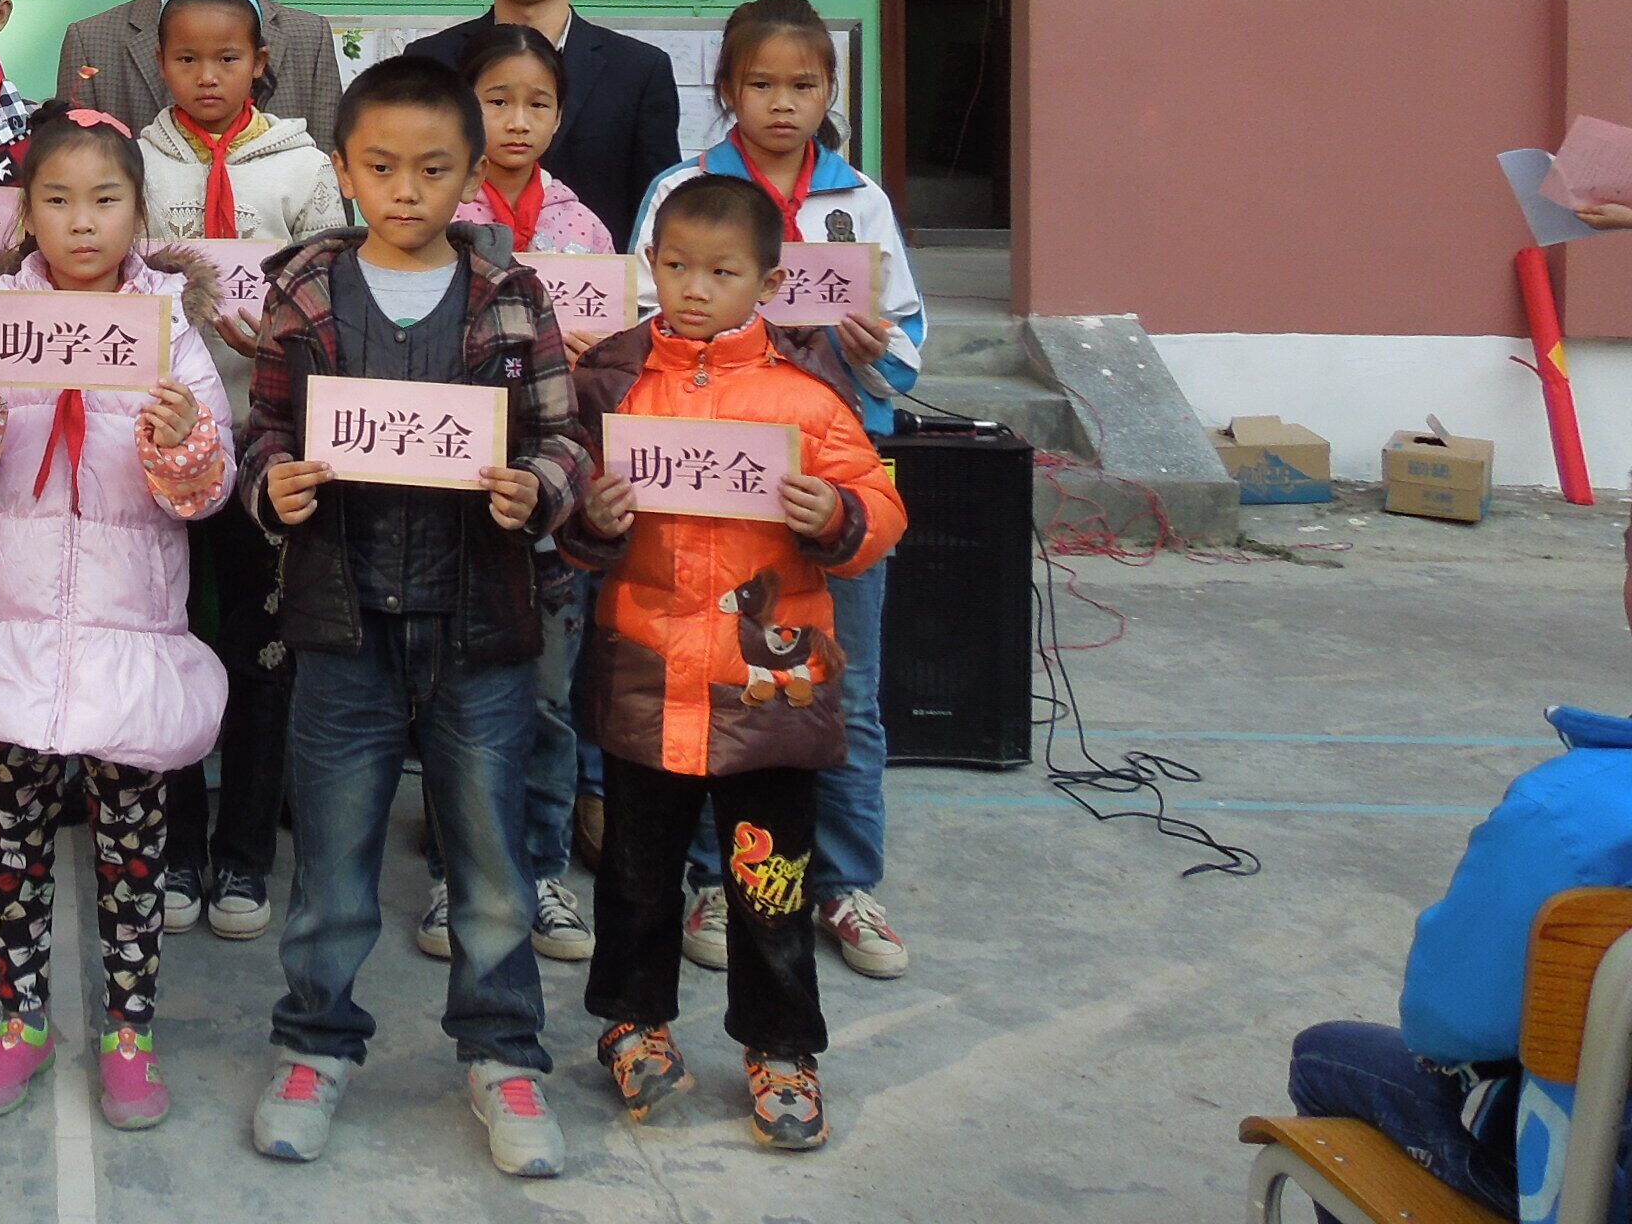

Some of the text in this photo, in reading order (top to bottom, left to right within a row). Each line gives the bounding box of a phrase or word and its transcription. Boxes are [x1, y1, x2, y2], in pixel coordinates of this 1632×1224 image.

[758, 268, 852, 305] 学金
[0, 320, 140, 367] 助学金
[331, 408, 473, 460] 助学金
[629, 445, 769, 495] 助学金
